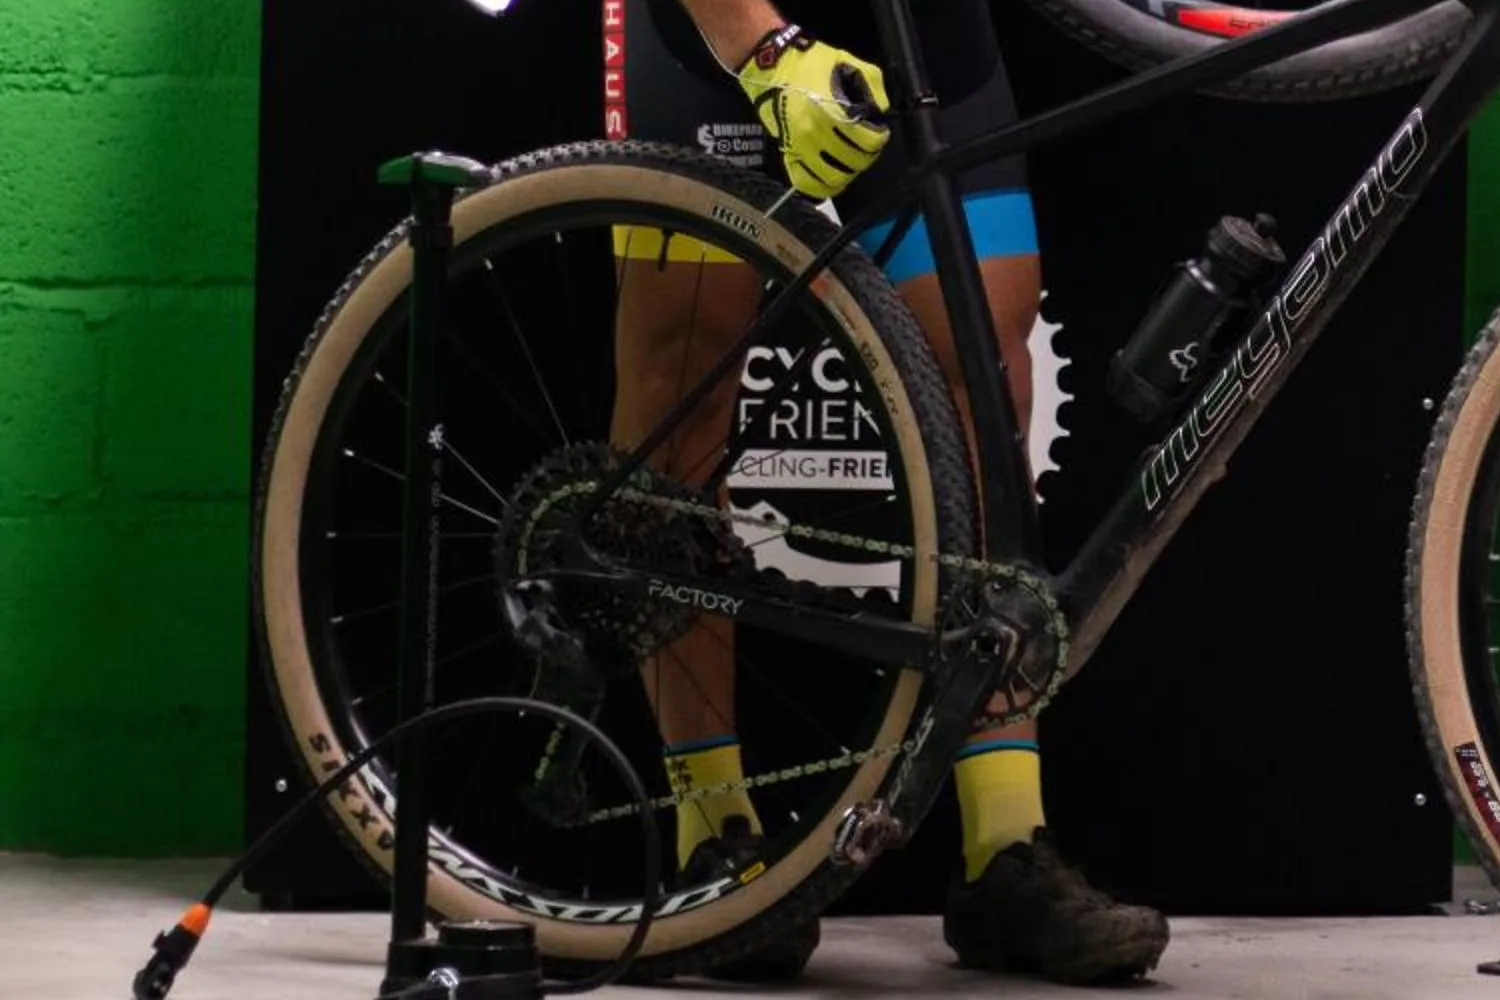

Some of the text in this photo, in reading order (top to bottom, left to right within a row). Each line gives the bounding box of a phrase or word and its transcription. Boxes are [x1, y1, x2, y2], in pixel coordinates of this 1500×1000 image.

[740, 346, 863, 393] CYC
[647, 578, 744, 615] FACTORY
[308, 733, 397, 851] AXXIS
